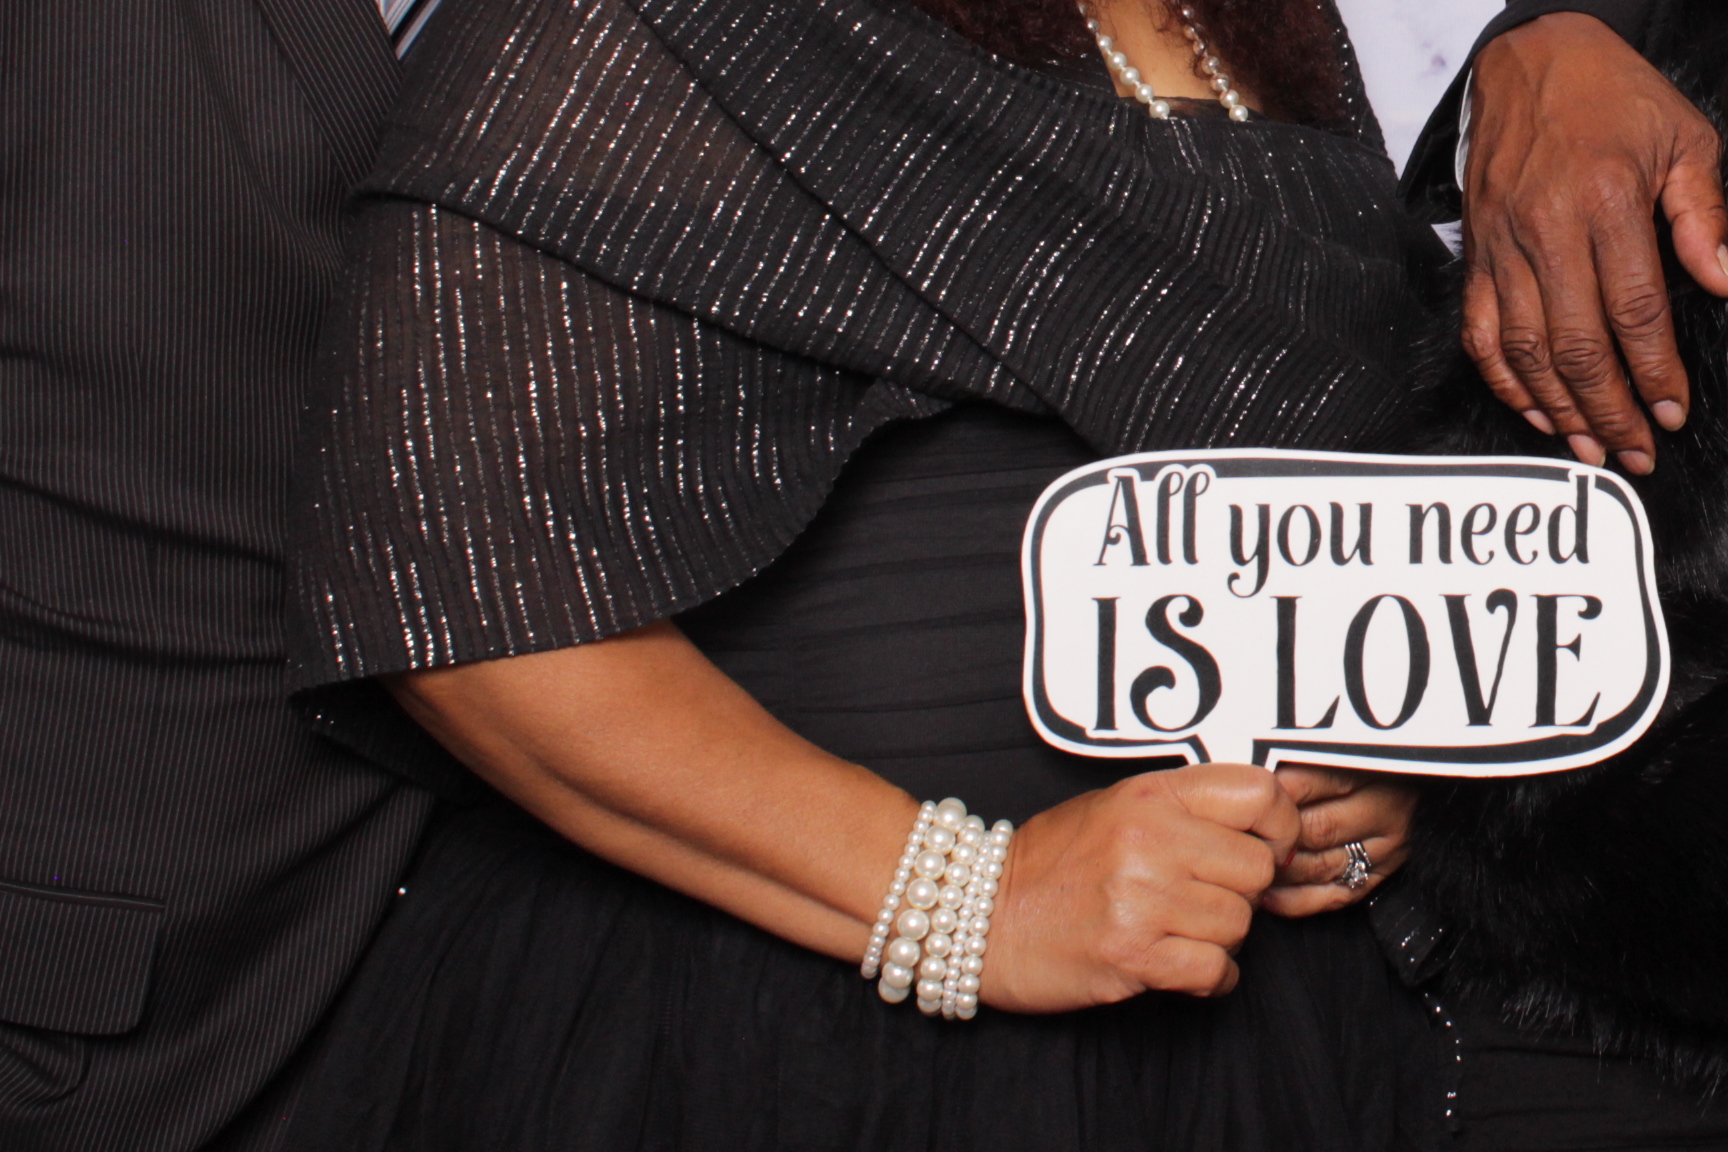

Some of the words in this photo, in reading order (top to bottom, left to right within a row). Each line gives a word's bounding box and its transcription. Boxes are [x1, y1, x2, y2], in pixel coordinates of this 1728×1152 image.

[1093, 470, 1211, 566] All
[1227, 501, 1375, 598] you
[1405, 473, 1591, 566] need
[1091, 594, 1222, 732] IS
[1269, 588, 1603, 730] LOVE
